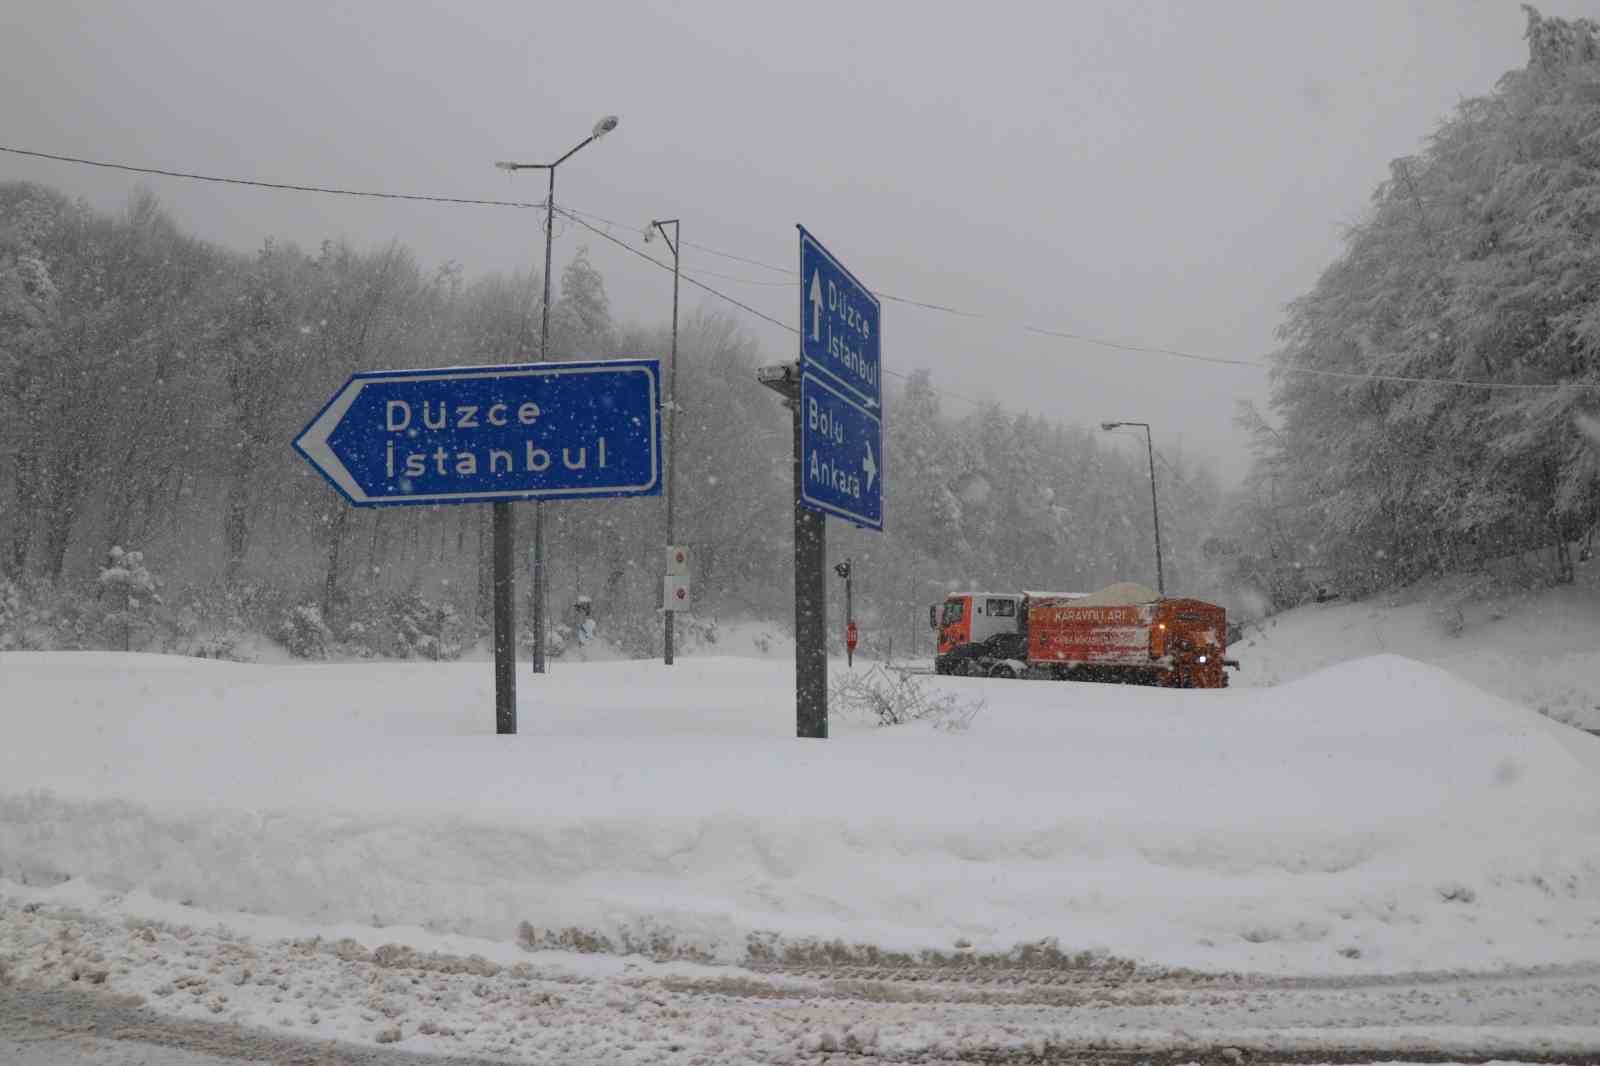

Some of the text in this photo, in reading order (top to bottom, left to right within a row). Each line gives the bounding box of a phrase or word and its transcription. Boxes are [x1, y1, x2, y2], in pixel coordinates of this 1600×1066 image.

[828, 279, 869, 340] Düzce
[828, 319, 879, 386] İstanbul
[386, 400, 541, 431] Düzce
[809, 396, 843, 444] Bolu
[386, 437, 608, 478] İstanbul
[809, 449, 860, 498] Ankara
